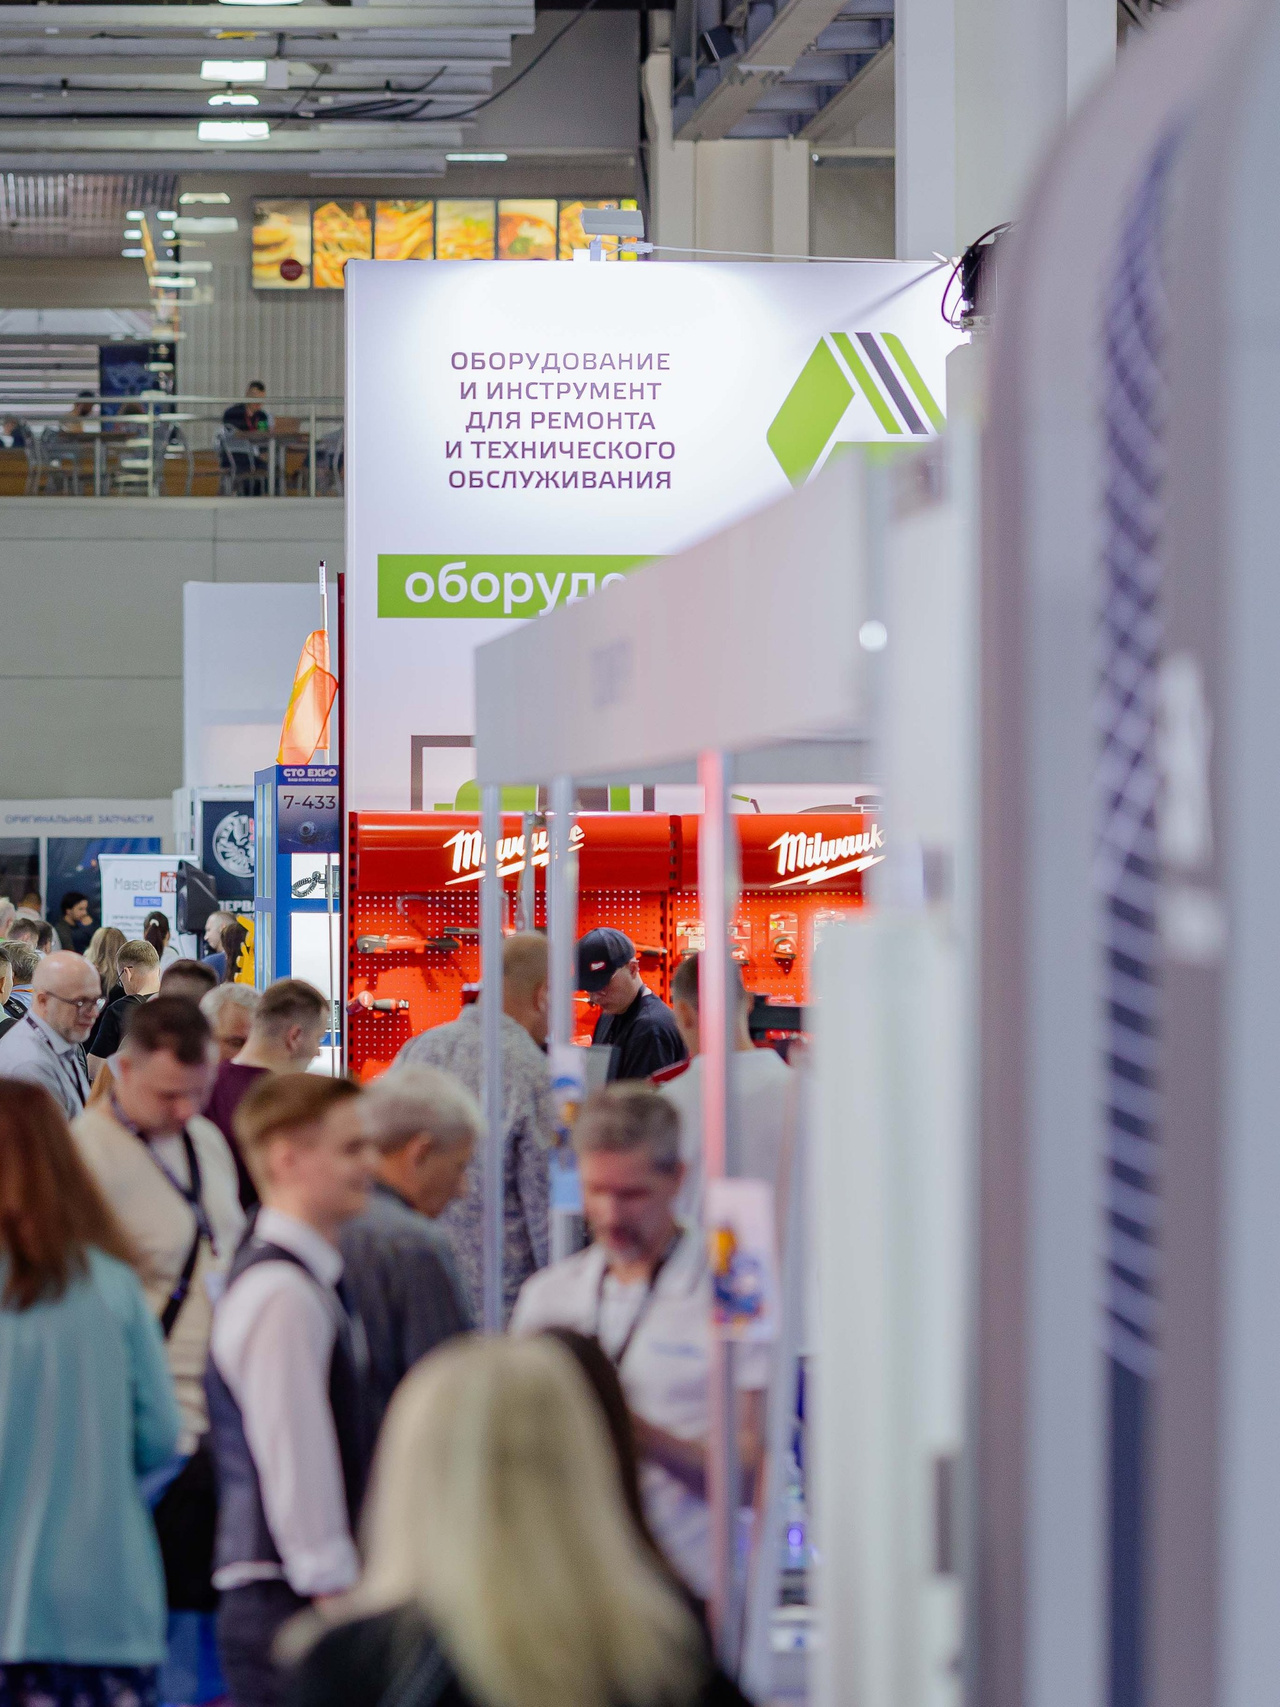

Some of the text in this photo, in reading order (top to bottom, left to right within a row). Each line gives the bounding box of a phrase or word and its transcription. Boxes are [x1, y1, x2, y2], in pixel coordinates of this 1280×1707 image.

[451, 352, 671, 374] ОБОРУДОВАНИЕ
[460, 382, 662, 400] И ИНСТРУМЕНТ
[465, 411, 656, 433] ДЛЯ РЕМОНТА
[445, 441, 676, 459] И ТЕХНИЧЕСКОГО
[448, 470, 672, 489] ОБСЛУЖИВАНИЯ
[283, 795, 336, 810] 7-433
[767, 823, 886, 876] Milwauk
